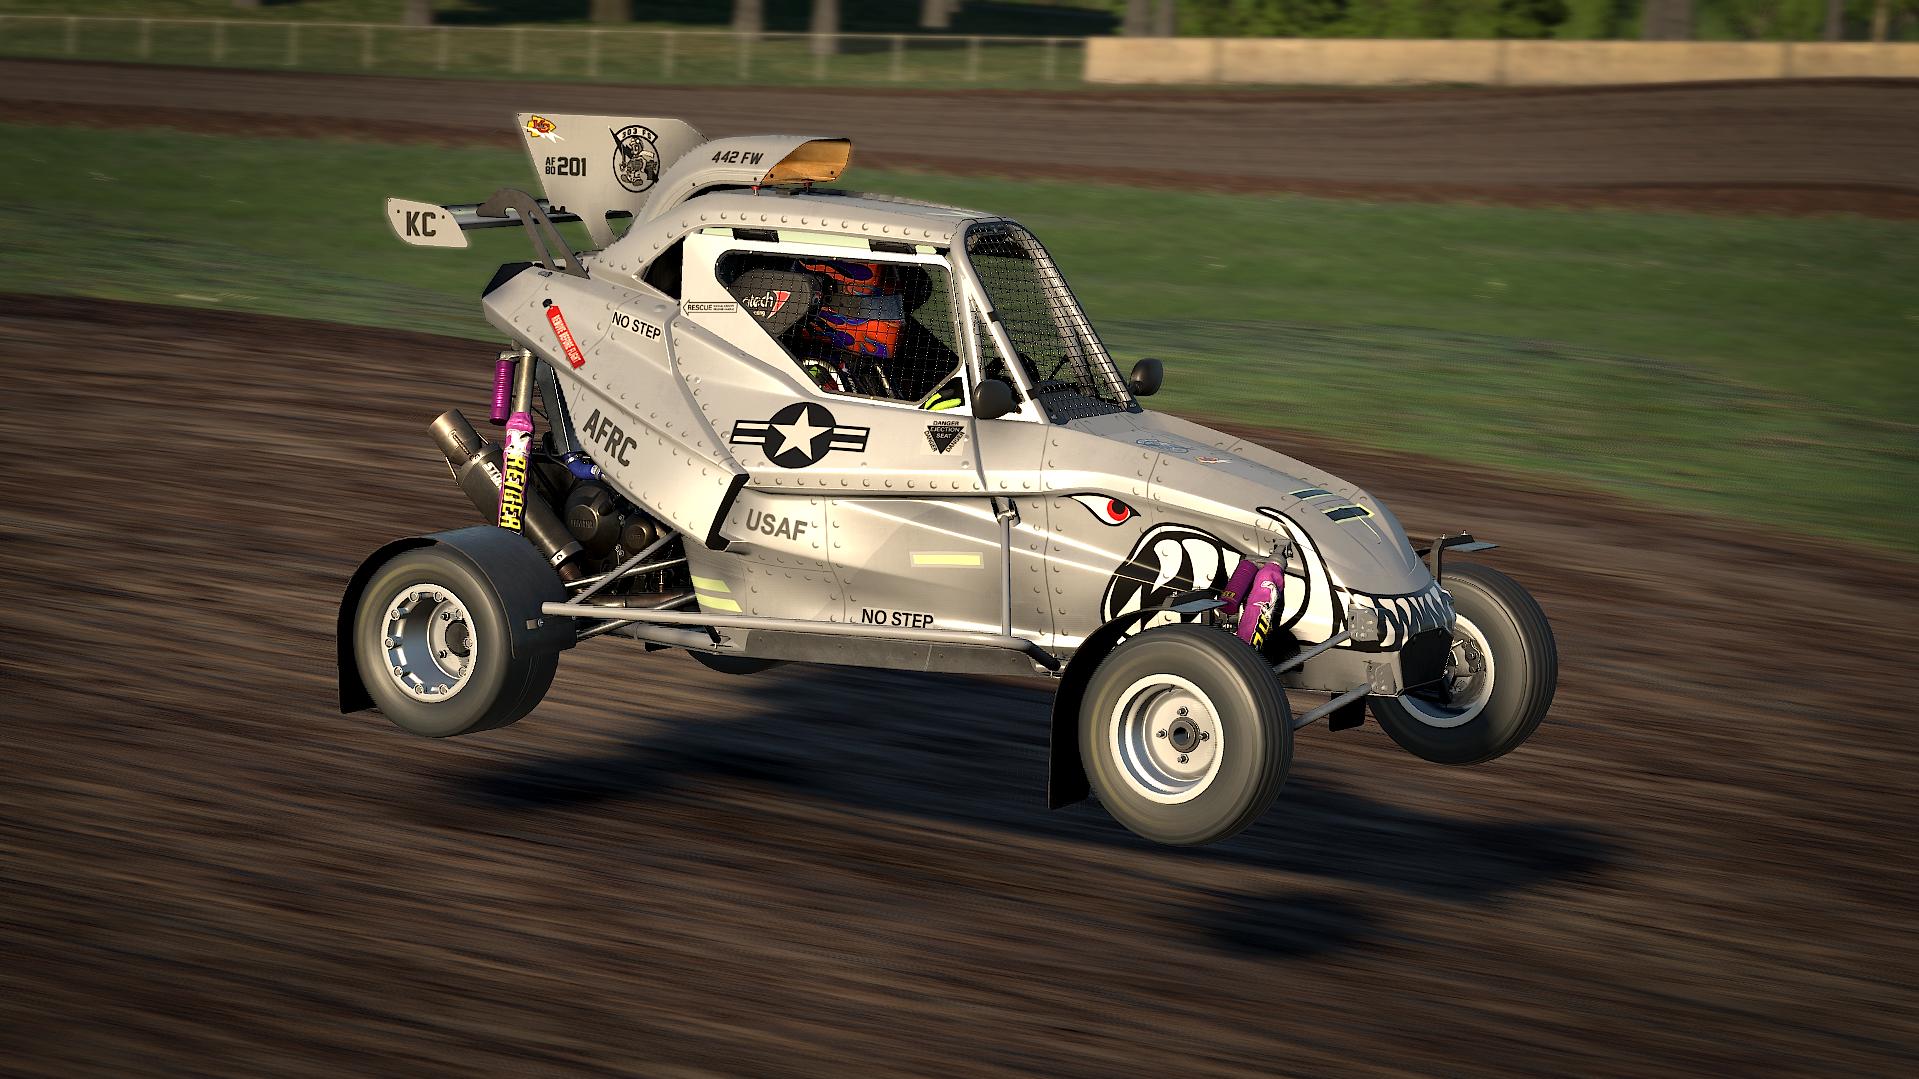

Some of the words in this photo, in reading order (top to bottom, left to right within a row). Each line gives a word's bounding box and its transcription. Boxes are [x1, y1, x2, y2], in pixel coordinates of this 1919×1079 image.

[545, 156, 556, 166] AF
[557, 156, 587, 177] 201
[711, 150, 738, 164] 442
[740, 152, 764, 165] FW
[406, 211, 437, 237] KC
[611, 311, 631, 329] NO
[631, 319, 662, 340] STEP
[582, 408, 637, 467] AFRC
[745, 508, 808, 541] USAF
[861, 608, 888, 625] NO
[891, 611, 934, 629] STEP
